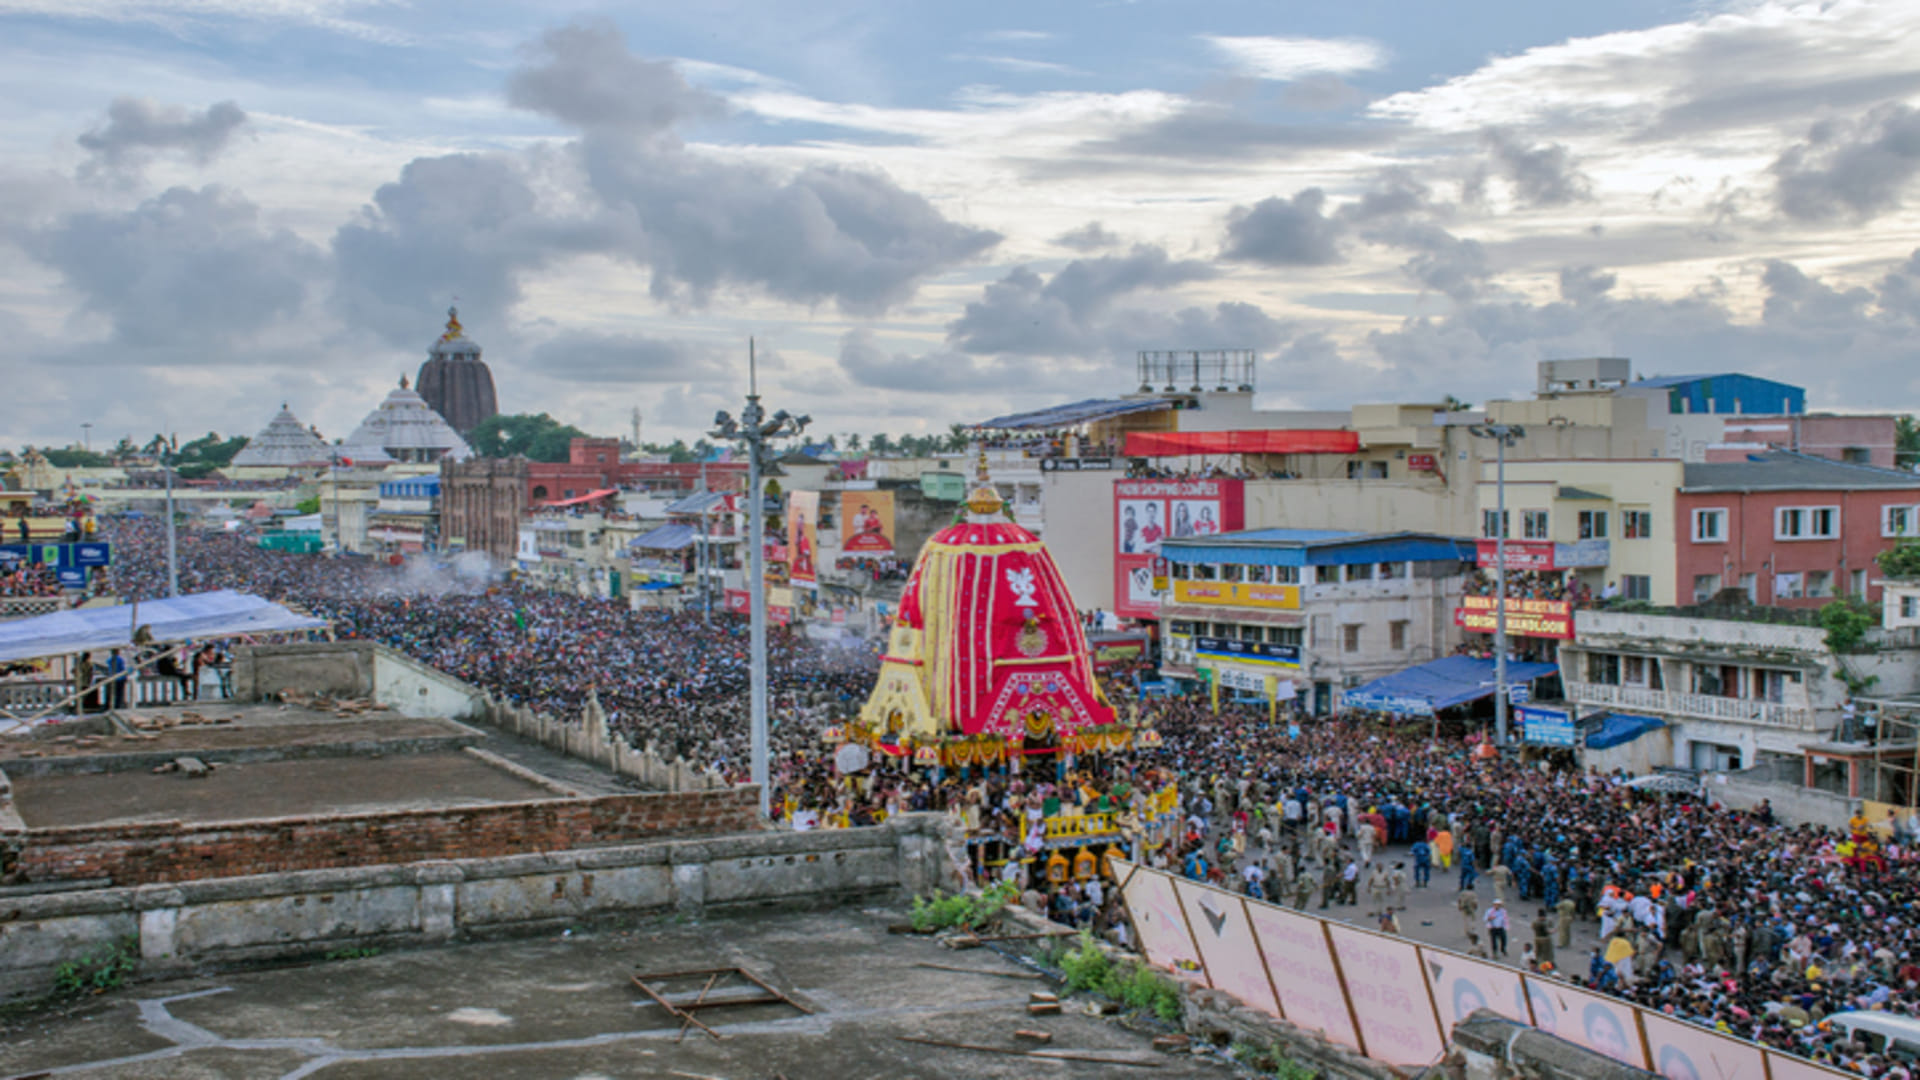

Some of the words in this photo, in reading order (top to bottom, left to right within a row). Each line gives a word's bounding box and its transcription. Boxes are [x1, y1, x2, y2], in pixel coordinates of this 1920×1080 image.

[1181, 481, 1219, 496] COMPLEX
[1464, 614, 1500, 628] ODISH
[1505, 617, 1567, 633] HANDLOOM
